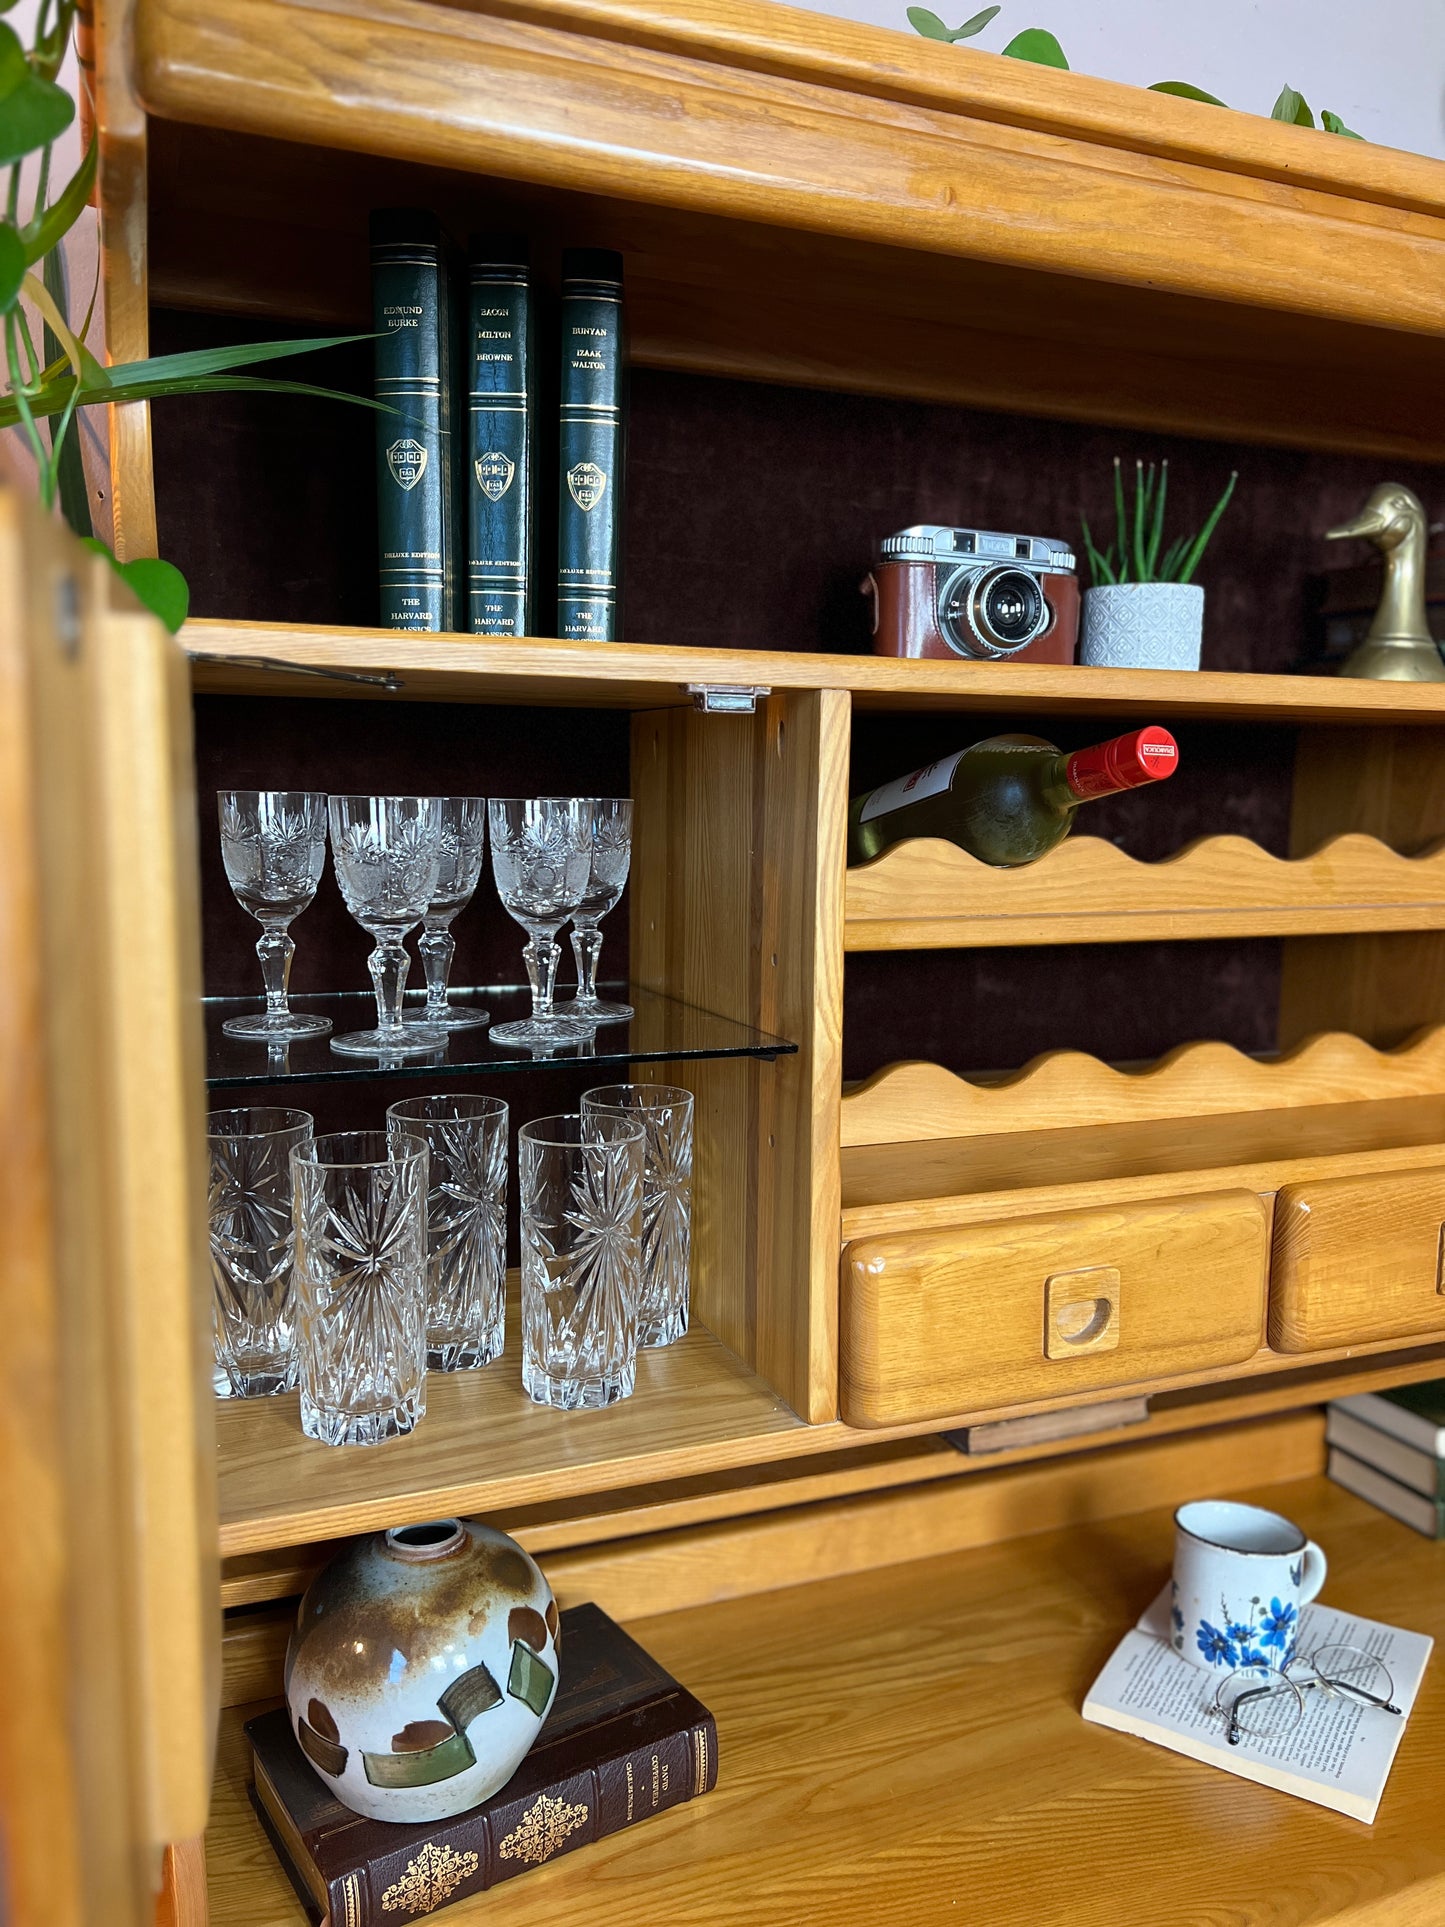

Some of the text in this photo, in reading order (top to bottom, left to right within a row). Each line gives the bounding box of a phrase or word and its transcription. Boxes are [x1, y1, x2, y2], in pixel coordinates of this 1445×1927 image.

[383, 306, 423, 315] EDMUND
[480, 308, 509, 317] BACON
[387, 319, 419, 327] BURKE
[478, 331, 512, 339] MILTON
[572, 328, 607, 337] BUNYAN
[476, 354, 513, 362] BROWNE
[576, 350, 602, 358] IZAAK
[571, 361, 606, 370] WALTON
[401, 598, 421, 606] THE
[485, 604, 503, 612] THE
[391, 612, 433, 620] HARVARD
[576, 612, 593, 620] THE
[474, 618, 515, 626] HARVARD
[565, 625, 604, 633] HARVARD
[651, 1755, 659, 1807] COPPERFIELD
